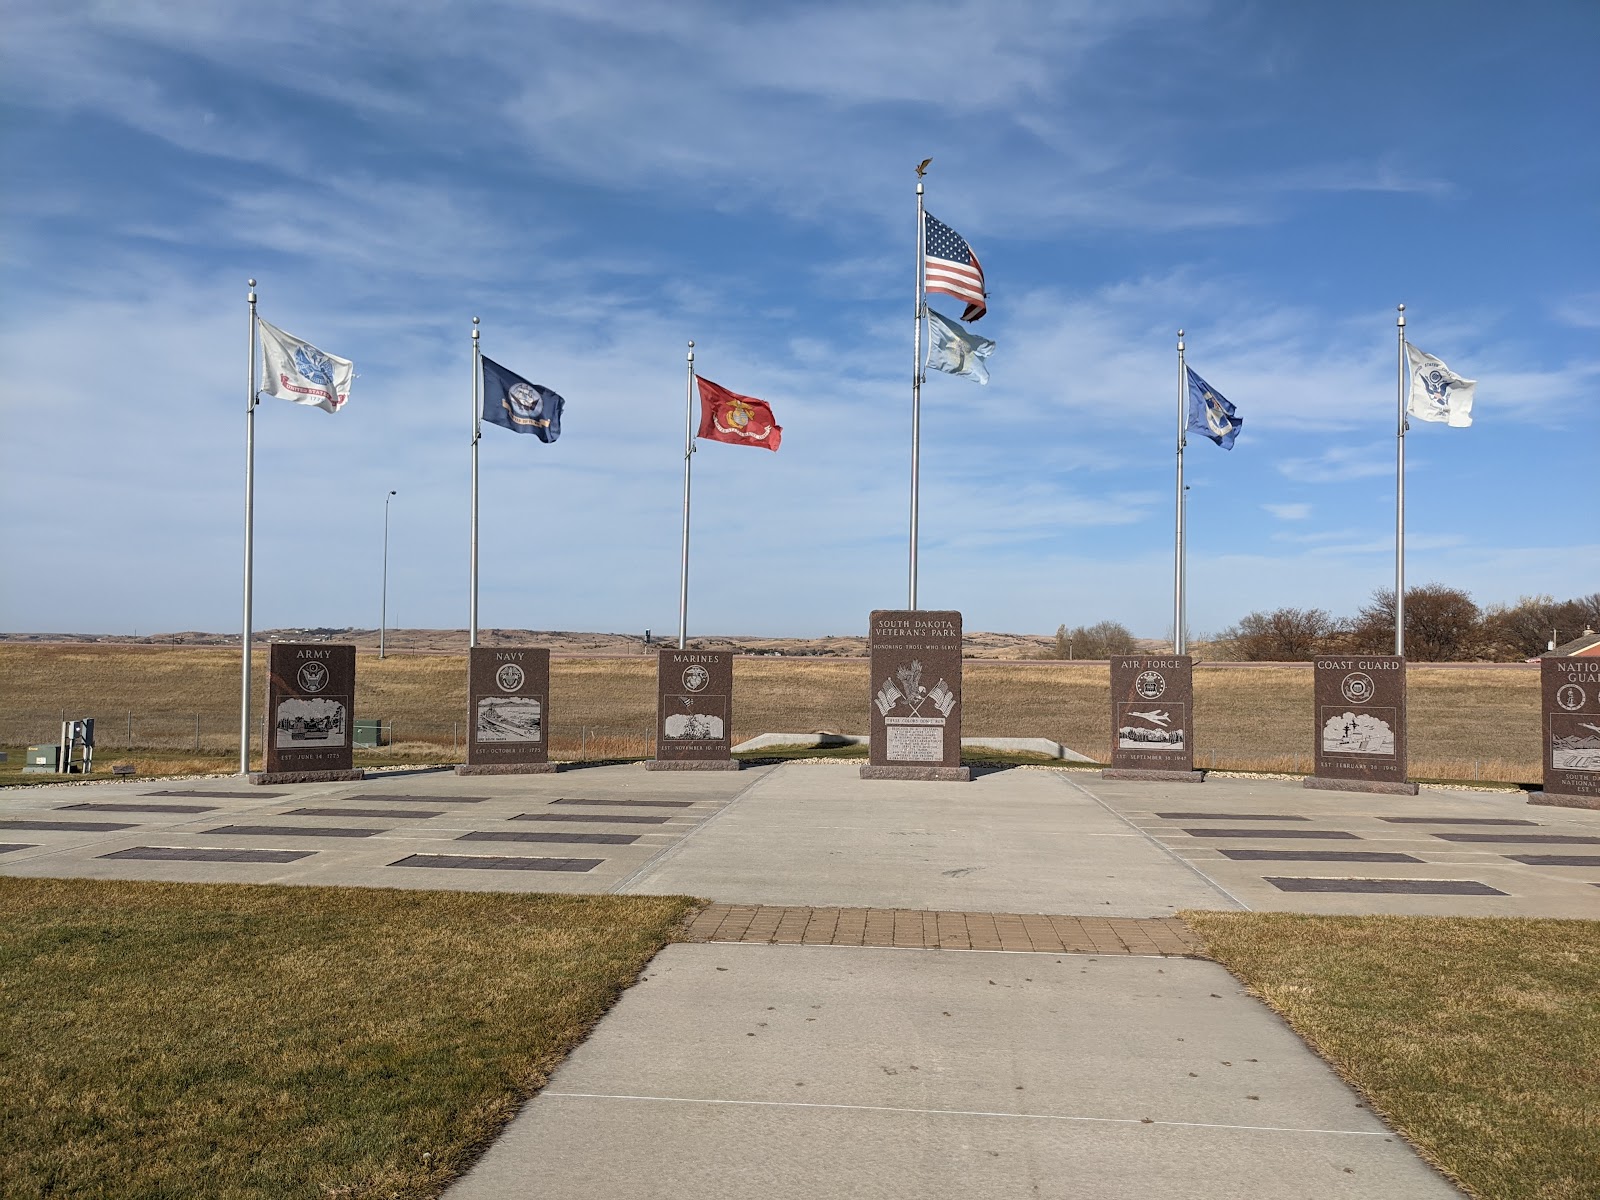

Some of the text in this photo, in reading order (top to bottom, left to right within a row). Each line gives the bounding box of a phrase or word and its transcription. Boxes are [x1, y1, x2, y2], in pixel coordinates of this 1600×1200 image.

[879, 620, 953, 629] SOUTH DAKOTA
[875, 628, 956, 637] VETERAN'S PARK
[296, 649, 332, 659] ARMY
[496, 652, 525, 661] NAVY
[673, 654, 719, 663] MARINES
[1121, 660, 1181, 669] AIR FORCE
[1317, 660, 1399, 670] COAST GUARD
[1565, 773, 1589, 781] SOUTH
[1561, 779, 1597, 787] NATIONAL
